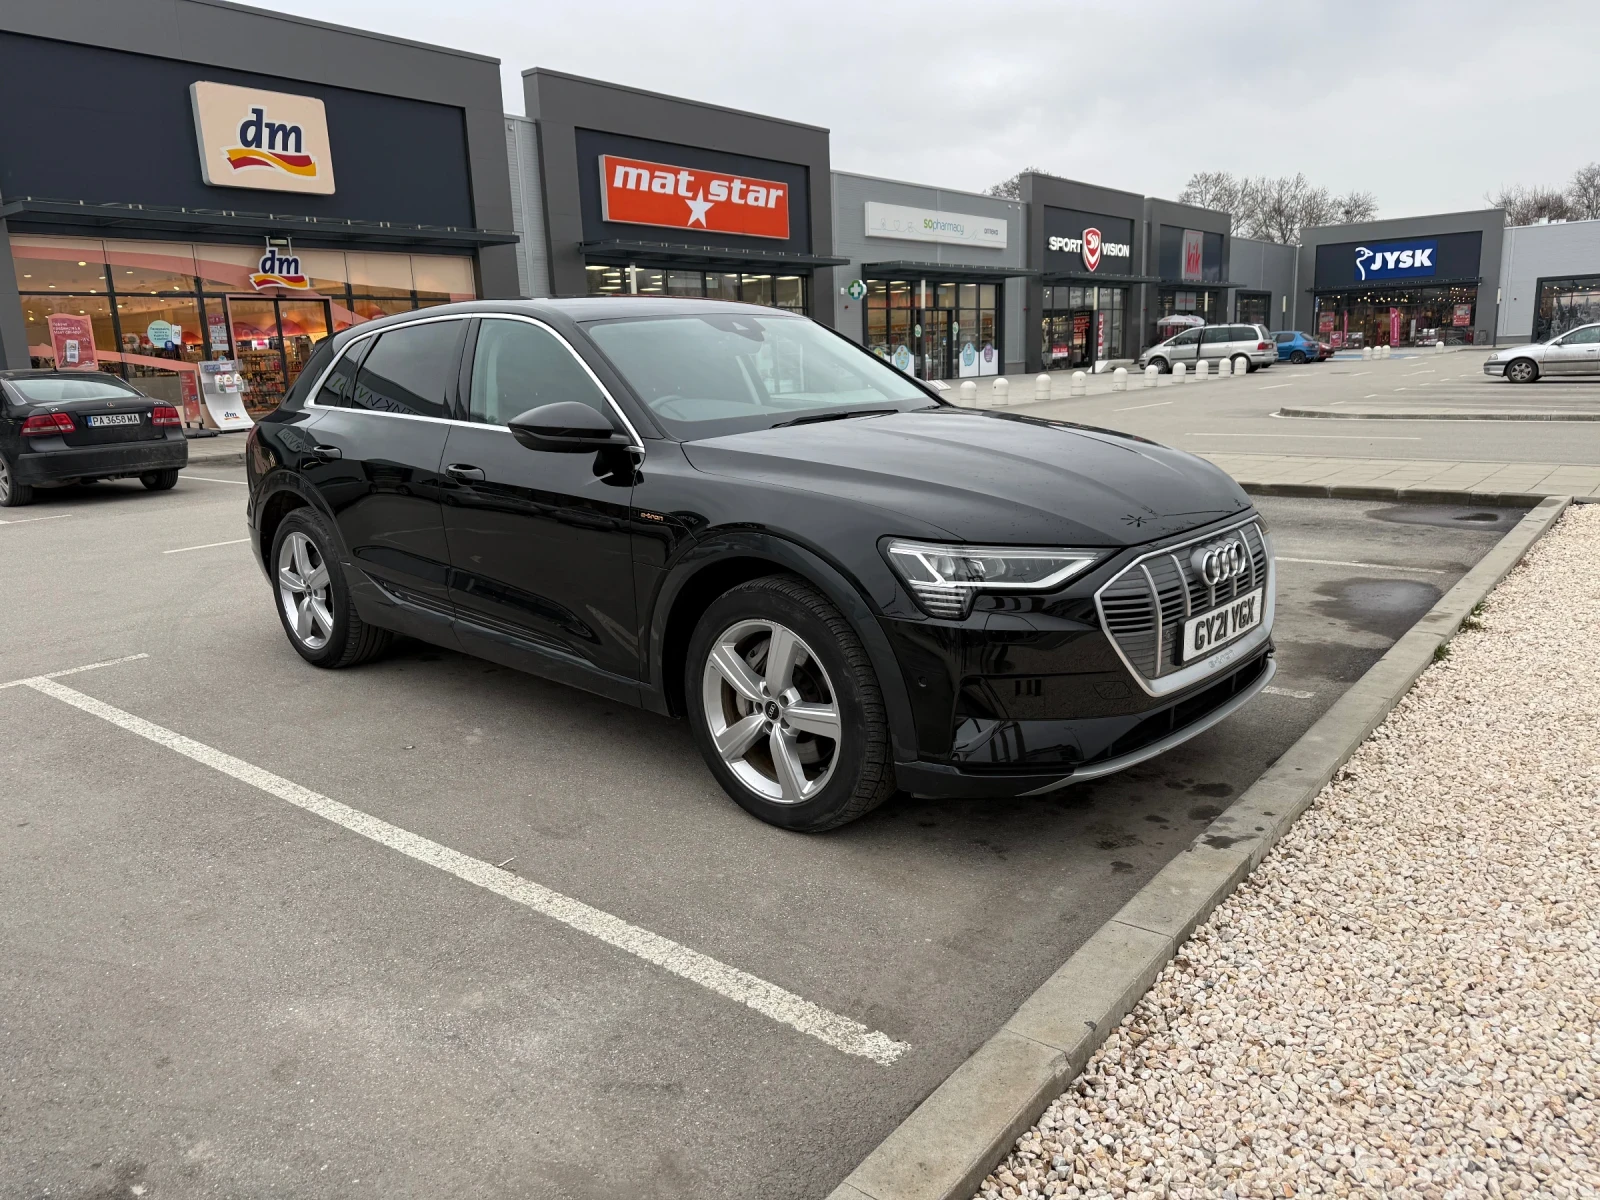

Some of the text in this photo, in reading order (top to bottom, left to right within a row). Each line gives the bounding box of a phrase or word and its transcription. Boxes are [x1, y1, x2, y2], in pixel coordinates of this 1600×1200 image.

[239, 108, 302, 153] dm
[613, 165, 783, 208] mat star
[1048, 236, 1130, 257] SPORT VISION
[261, 249, 299, 275] dm
[1370, 248, 1433, 270] JYSK
[106, 416, 126, 424] 3658
[127, 415, 139, 423] MA
[640, 512, 664, 521] e-tron
[1195, 596, 1255, 650] GY21 YGX
